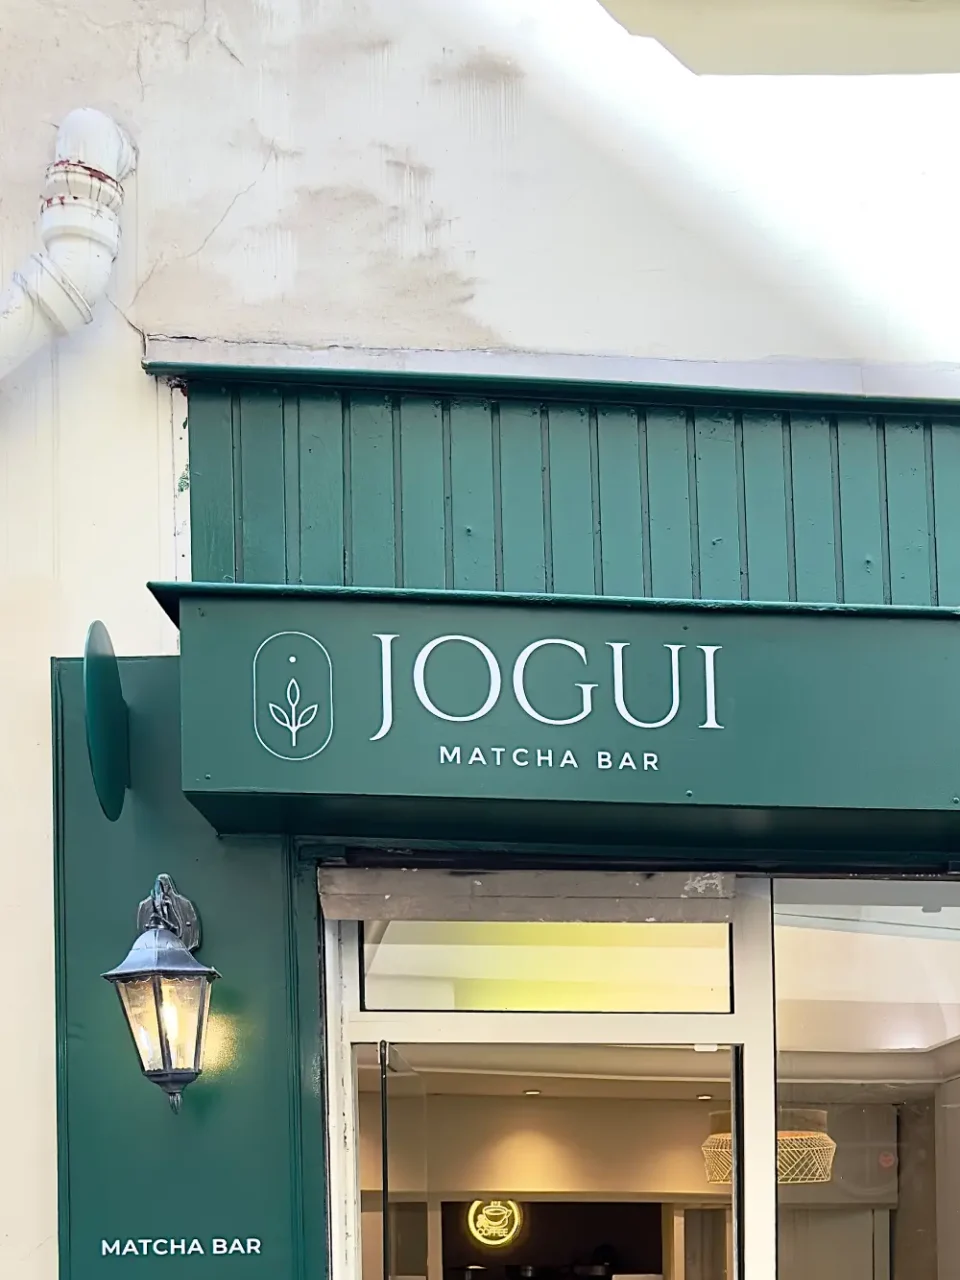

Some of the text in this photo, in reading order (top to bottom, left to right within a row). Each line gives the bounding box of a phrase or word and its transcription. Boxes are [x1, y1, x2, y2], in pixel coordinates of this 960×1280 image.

[369, 633, 725, 741] JOGUI
[439, 746, 659, 771] MATCHA BAR
[101, 1237, 262, 1256] MATCHA BAR
